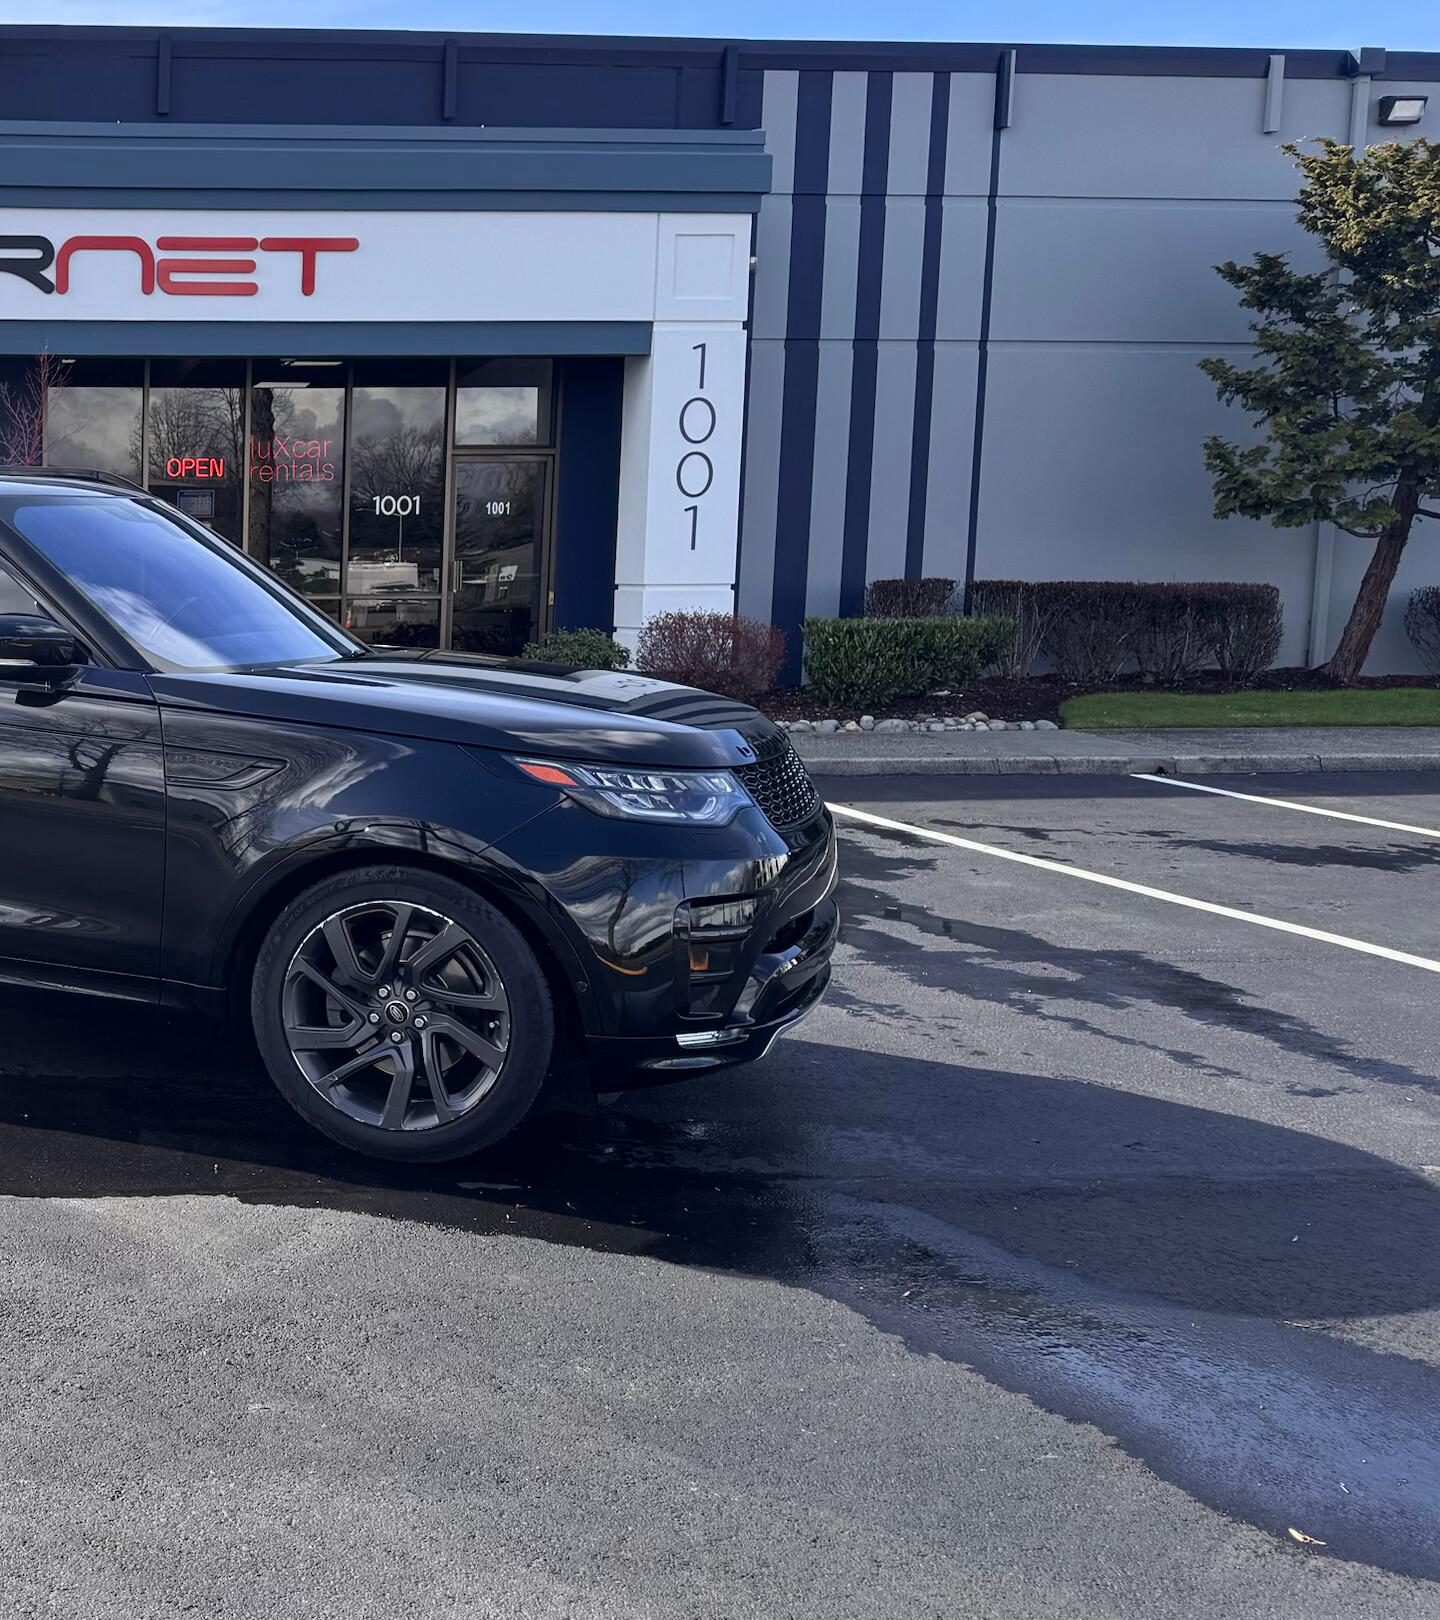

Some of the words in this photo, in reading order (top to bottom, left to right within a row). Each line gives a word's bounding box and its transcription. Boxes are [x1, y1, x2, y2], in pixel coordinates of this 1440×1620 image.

[676, 343, 716, 550] 1001
[166, 457, 224, 479] OPEN
[250, 458, 335, 483] rentals
[372, 495, 420, 516] 1001
[486, 501, 511, 516] 1001
